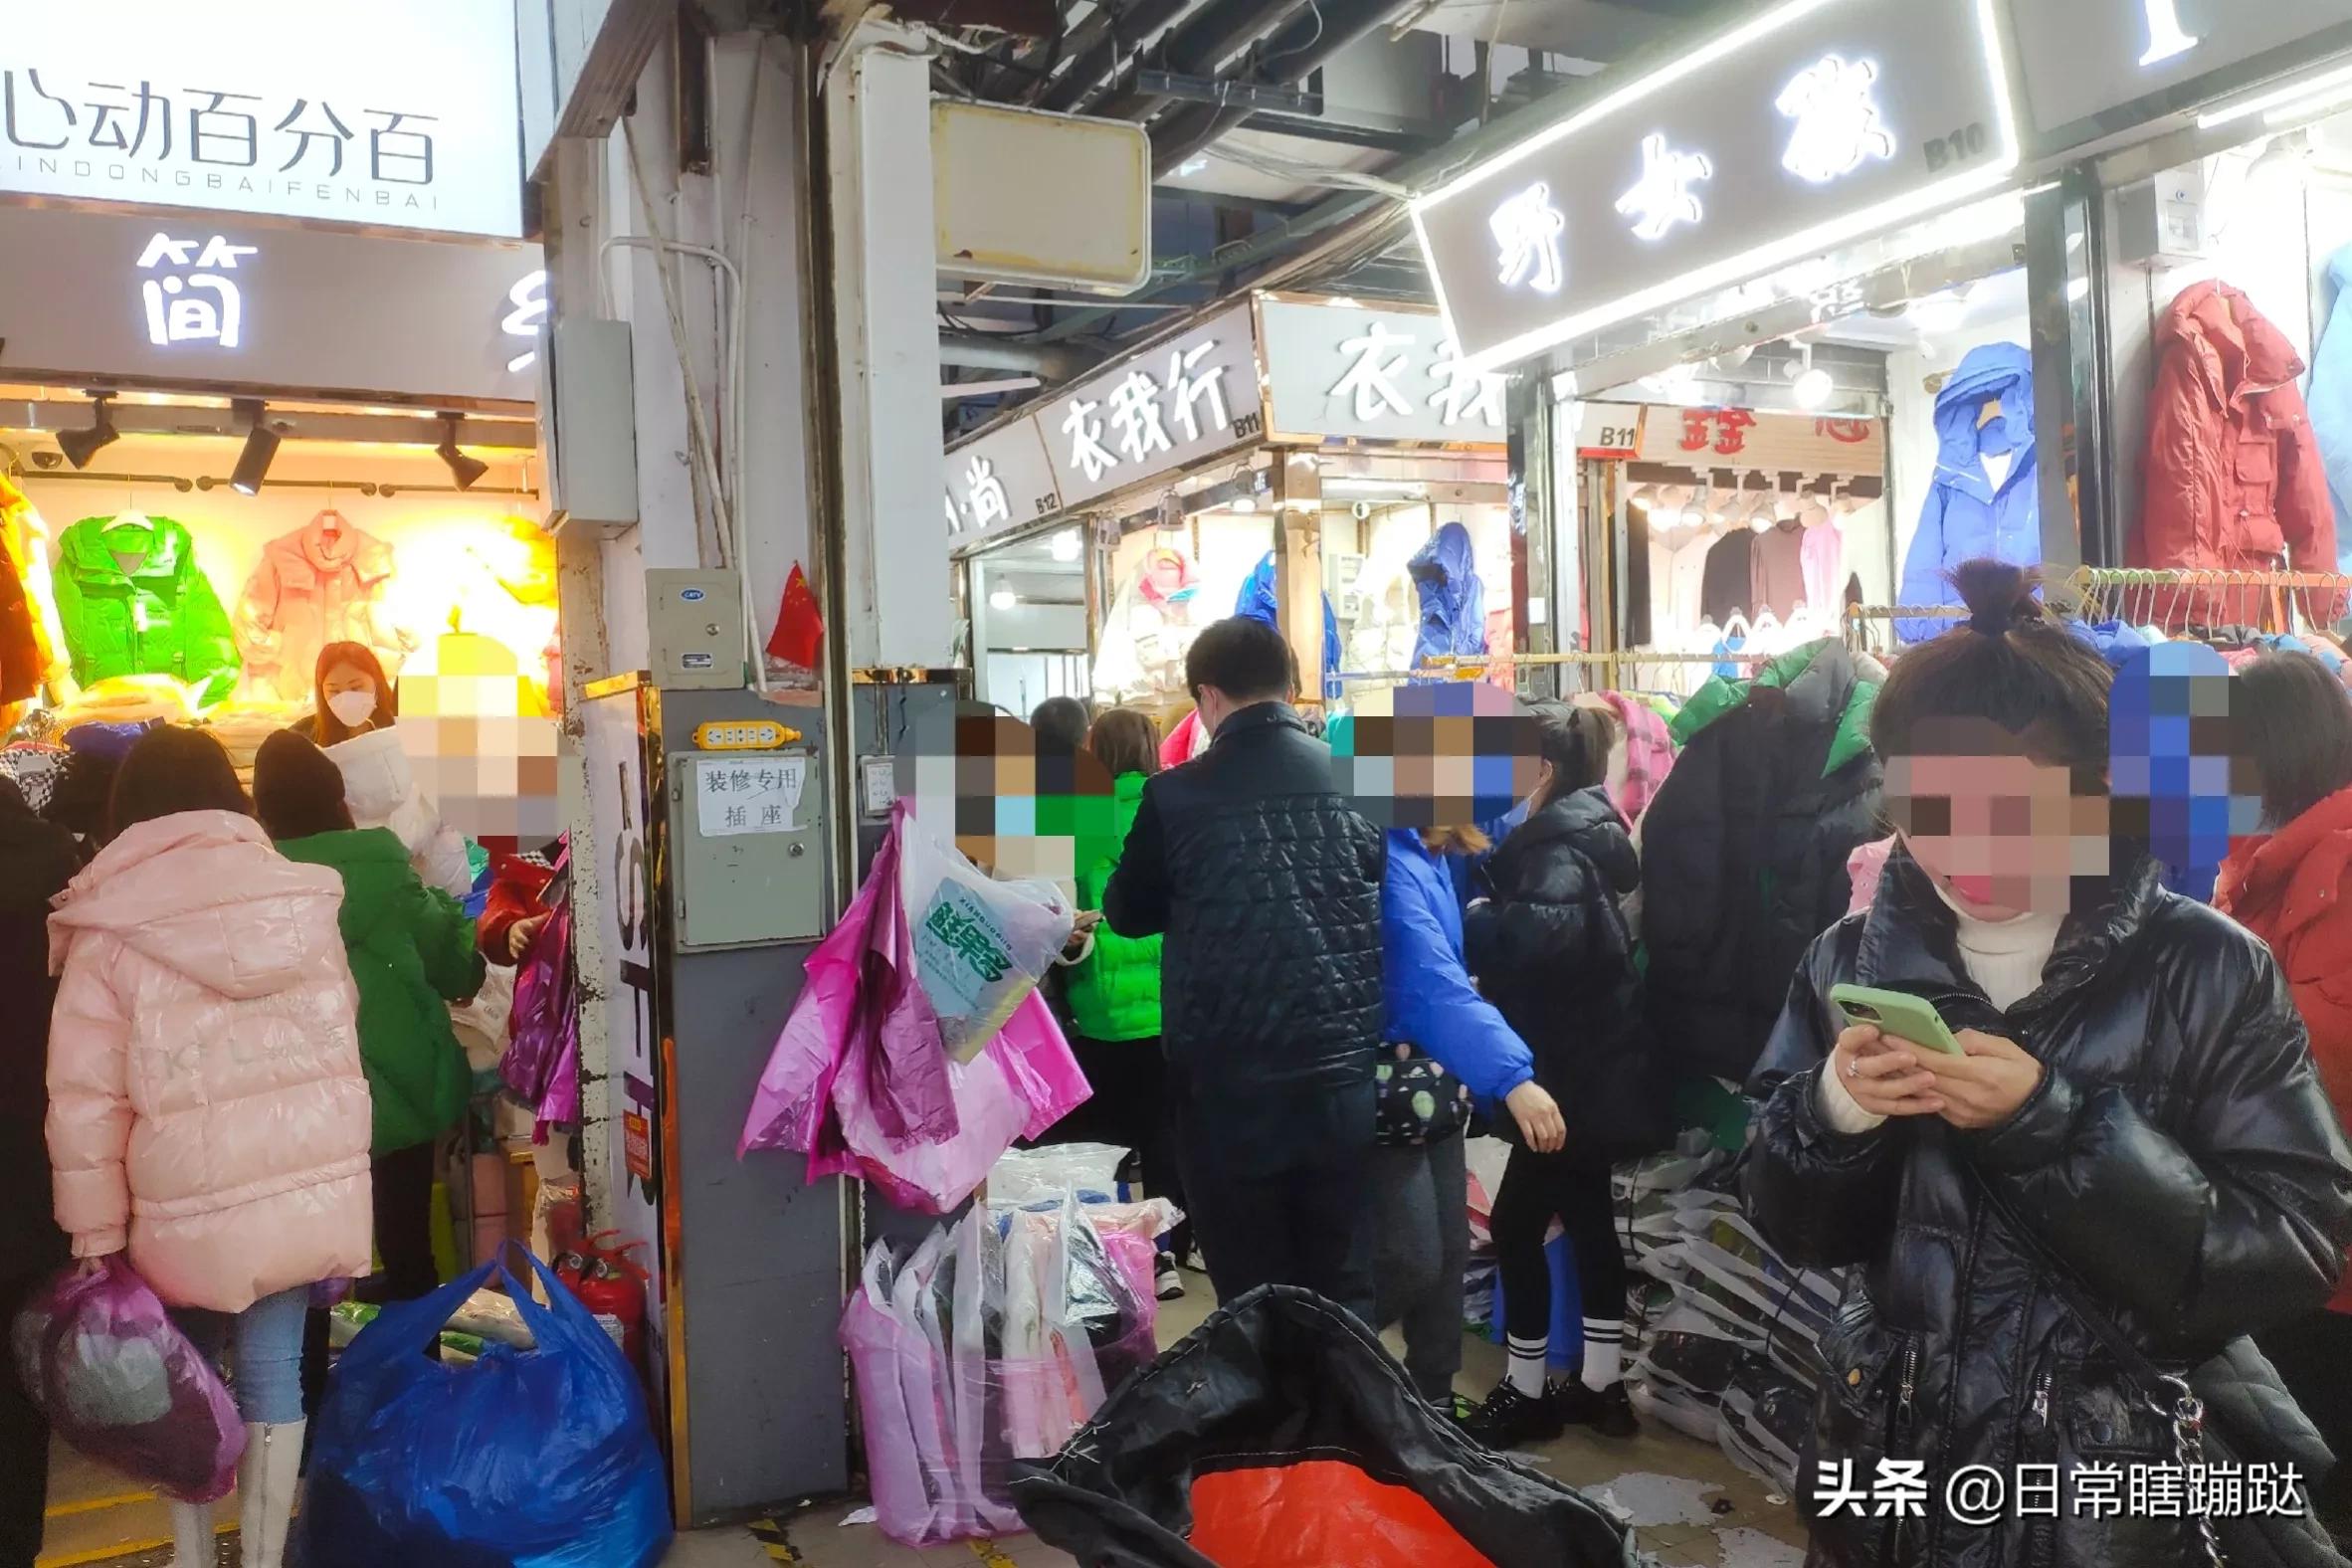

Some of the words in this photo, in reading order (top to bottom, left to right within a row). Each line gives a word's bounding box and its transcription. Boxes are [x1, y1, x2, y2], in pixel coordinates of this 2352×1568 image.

[4, 68, 439, 185] 心动百分百
[1922, 122, 1988, 173] B10
[1062, 339, 1230, 482] 衣我行
[1233, 413, 1261, 440] B11
[1600, 426, 1636, 447] B11
[1035, 492, 1058, 514] B12
[705, 768, 796, 793] 装修专用
[925, 901, 1013, 982] 鲜果多
